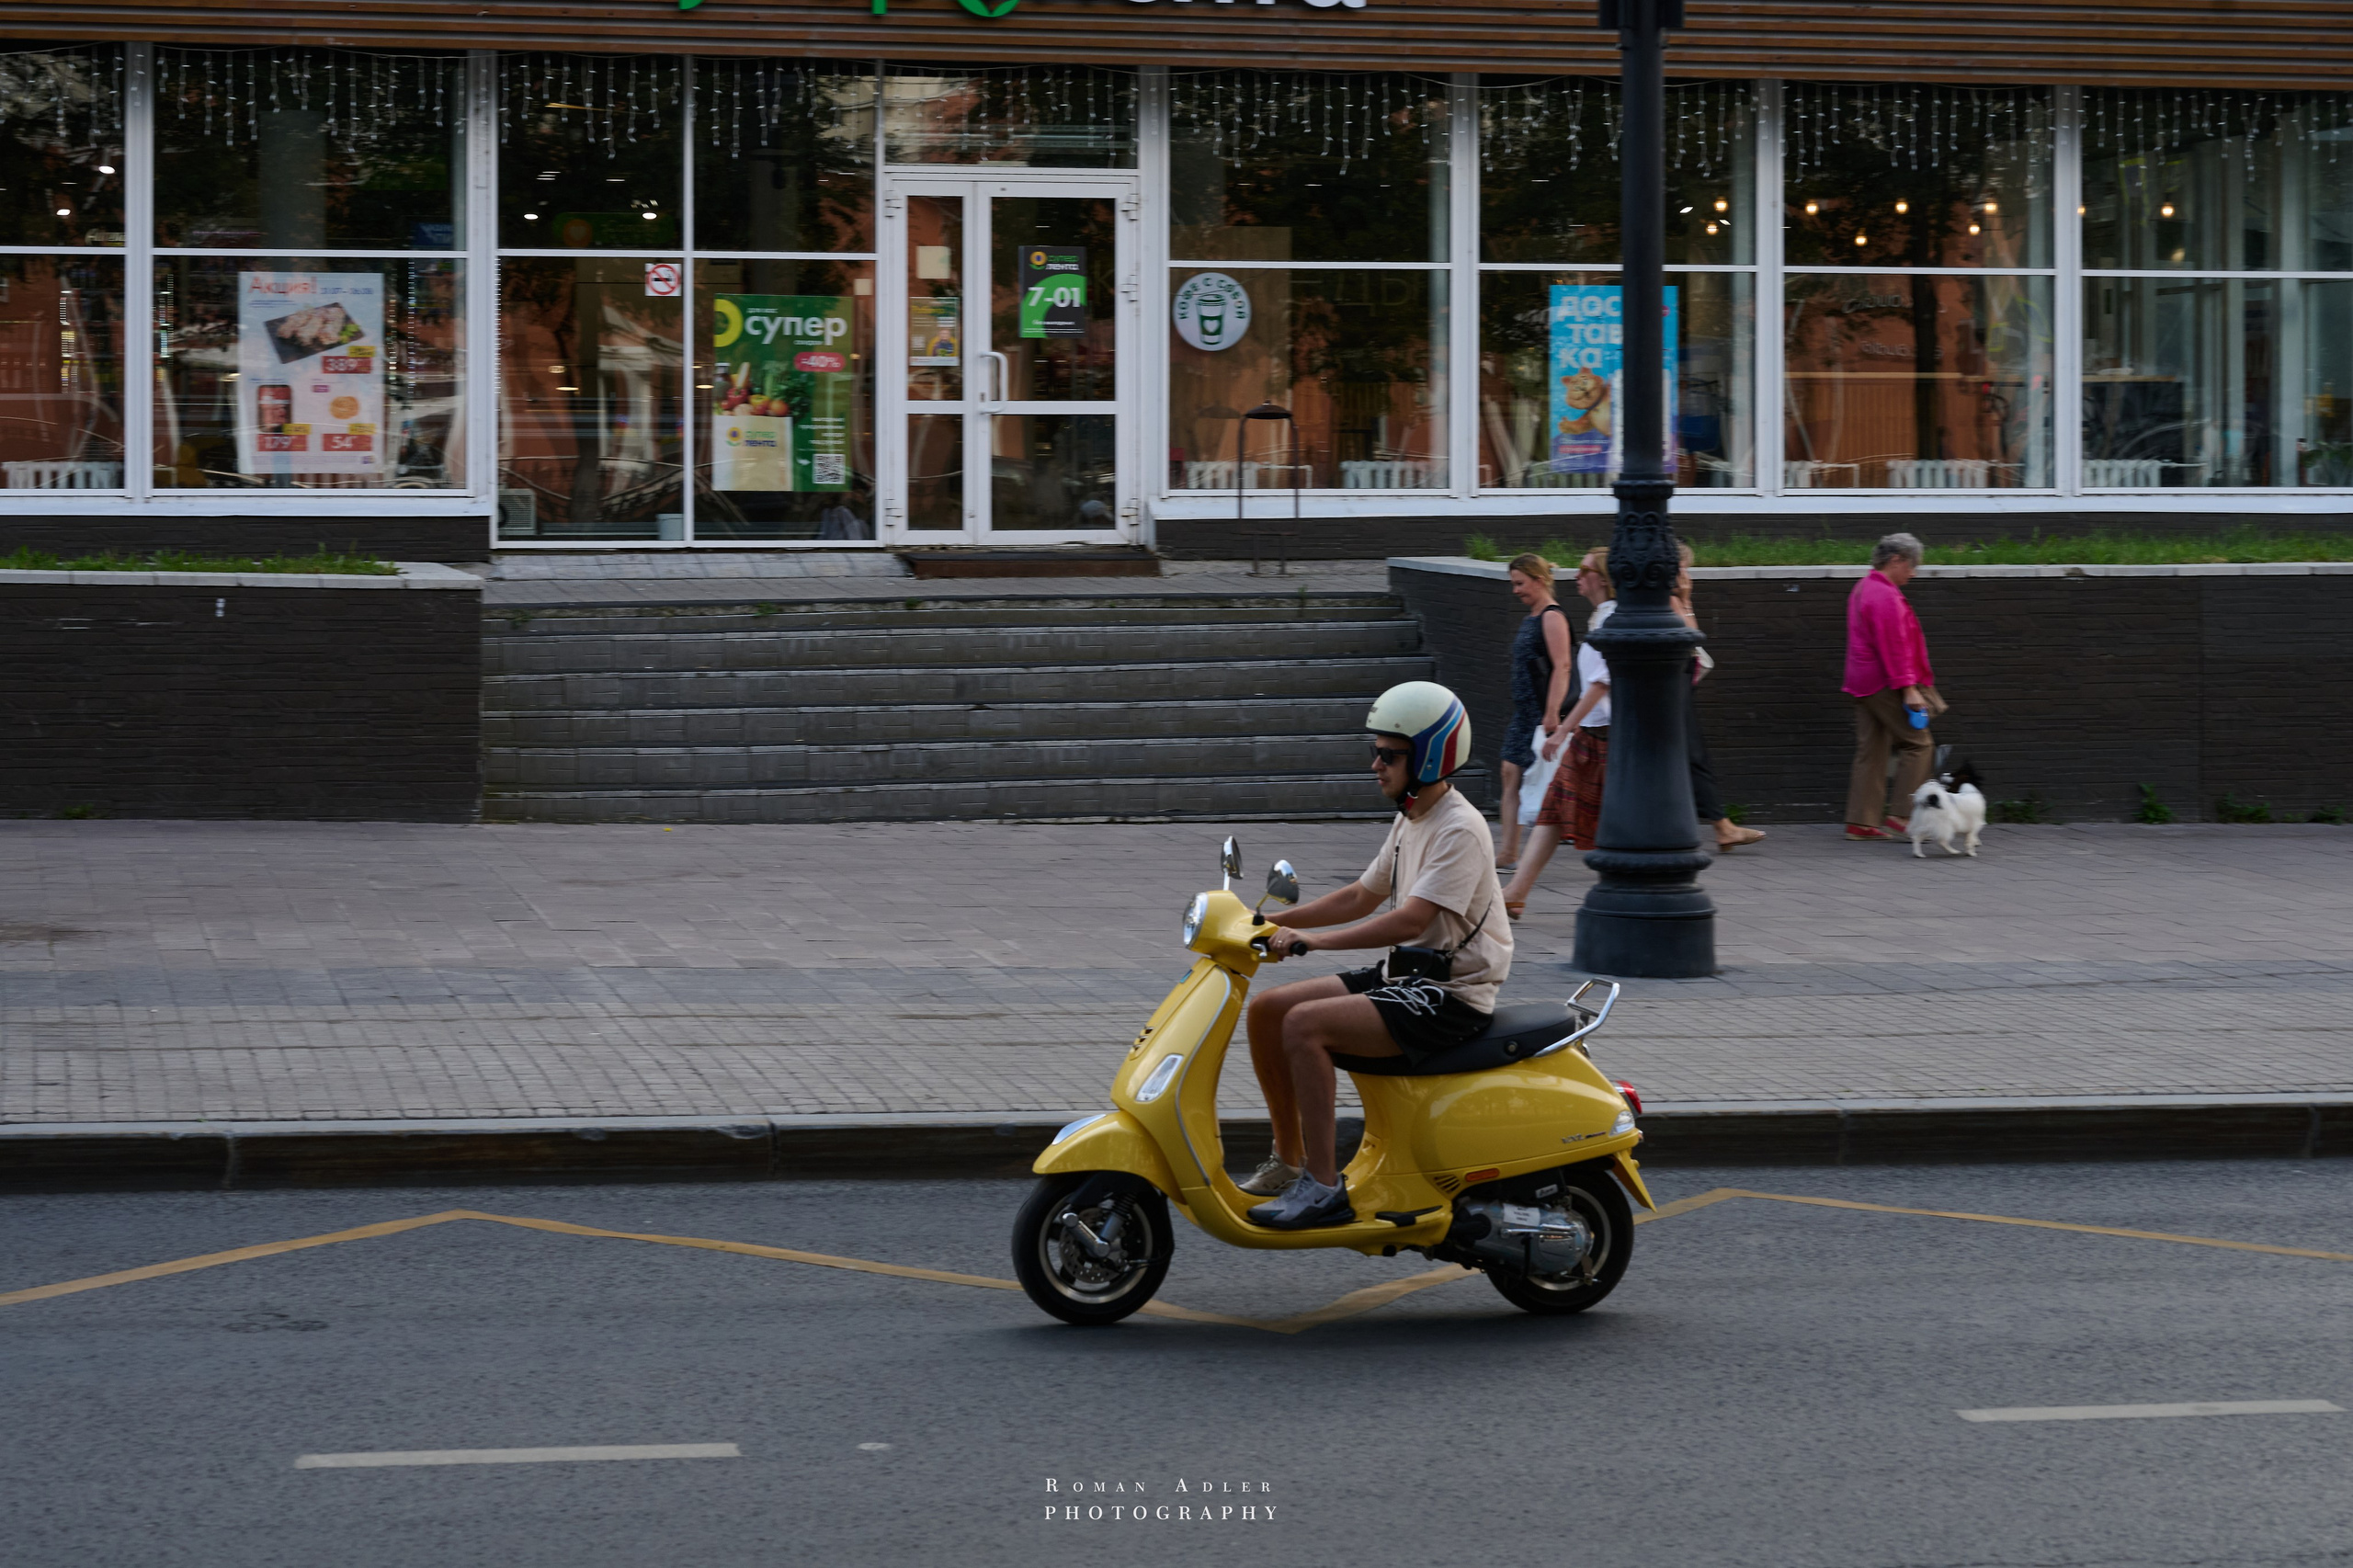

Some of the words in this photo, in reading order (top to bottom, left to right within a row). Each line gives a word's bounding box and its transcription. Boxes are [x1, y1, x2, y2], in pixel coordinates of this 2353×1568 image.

[248, 277, 317, 296] Акция!
[1202, 278, 1213, 287] С
[1028, 286, 1081, 308] 7-01
[744, 315, 848, 347] супер
